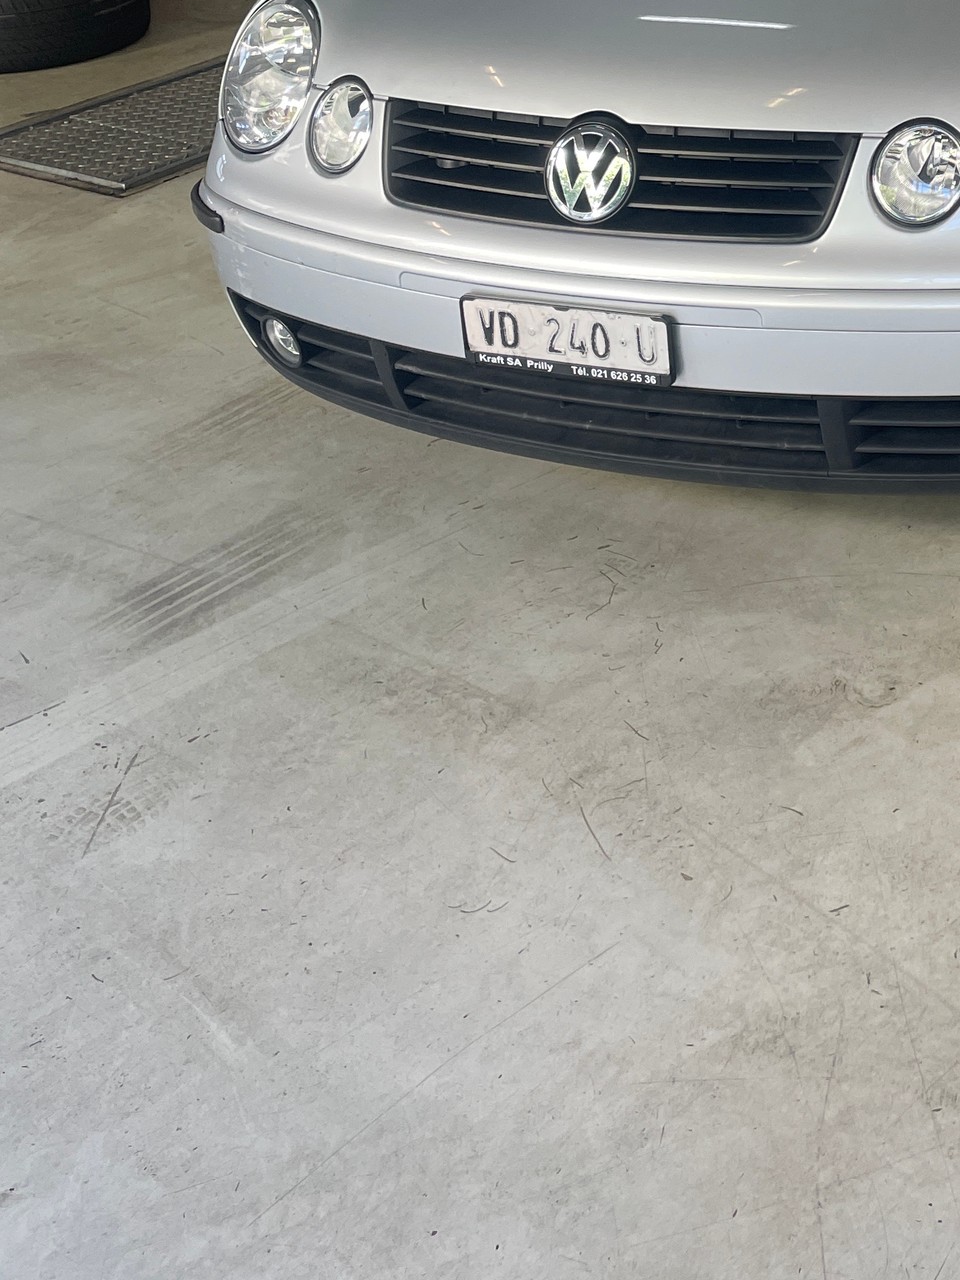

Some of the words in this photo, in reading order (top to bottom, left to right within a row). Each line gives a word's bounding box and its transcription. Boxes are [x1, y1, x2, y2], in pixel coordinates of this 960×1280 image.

[545, 124, 633, 221] VW
[478, 308, 520, 349] VD
[544, 318, 611, 360] 240
[634, 323, 658, 365] U
[479, 353, 505, 365] Kraft
[506, 357, 523, 367] SA
[527, 359, 553, 373] Prilly
[571, 365, 590, 377] Tél.
[591, 368, 608, 379] 021
[610, 370, 629, 381] 626
[630, 373, 643, 383] 25
[644, 375, 657, 385] 36
